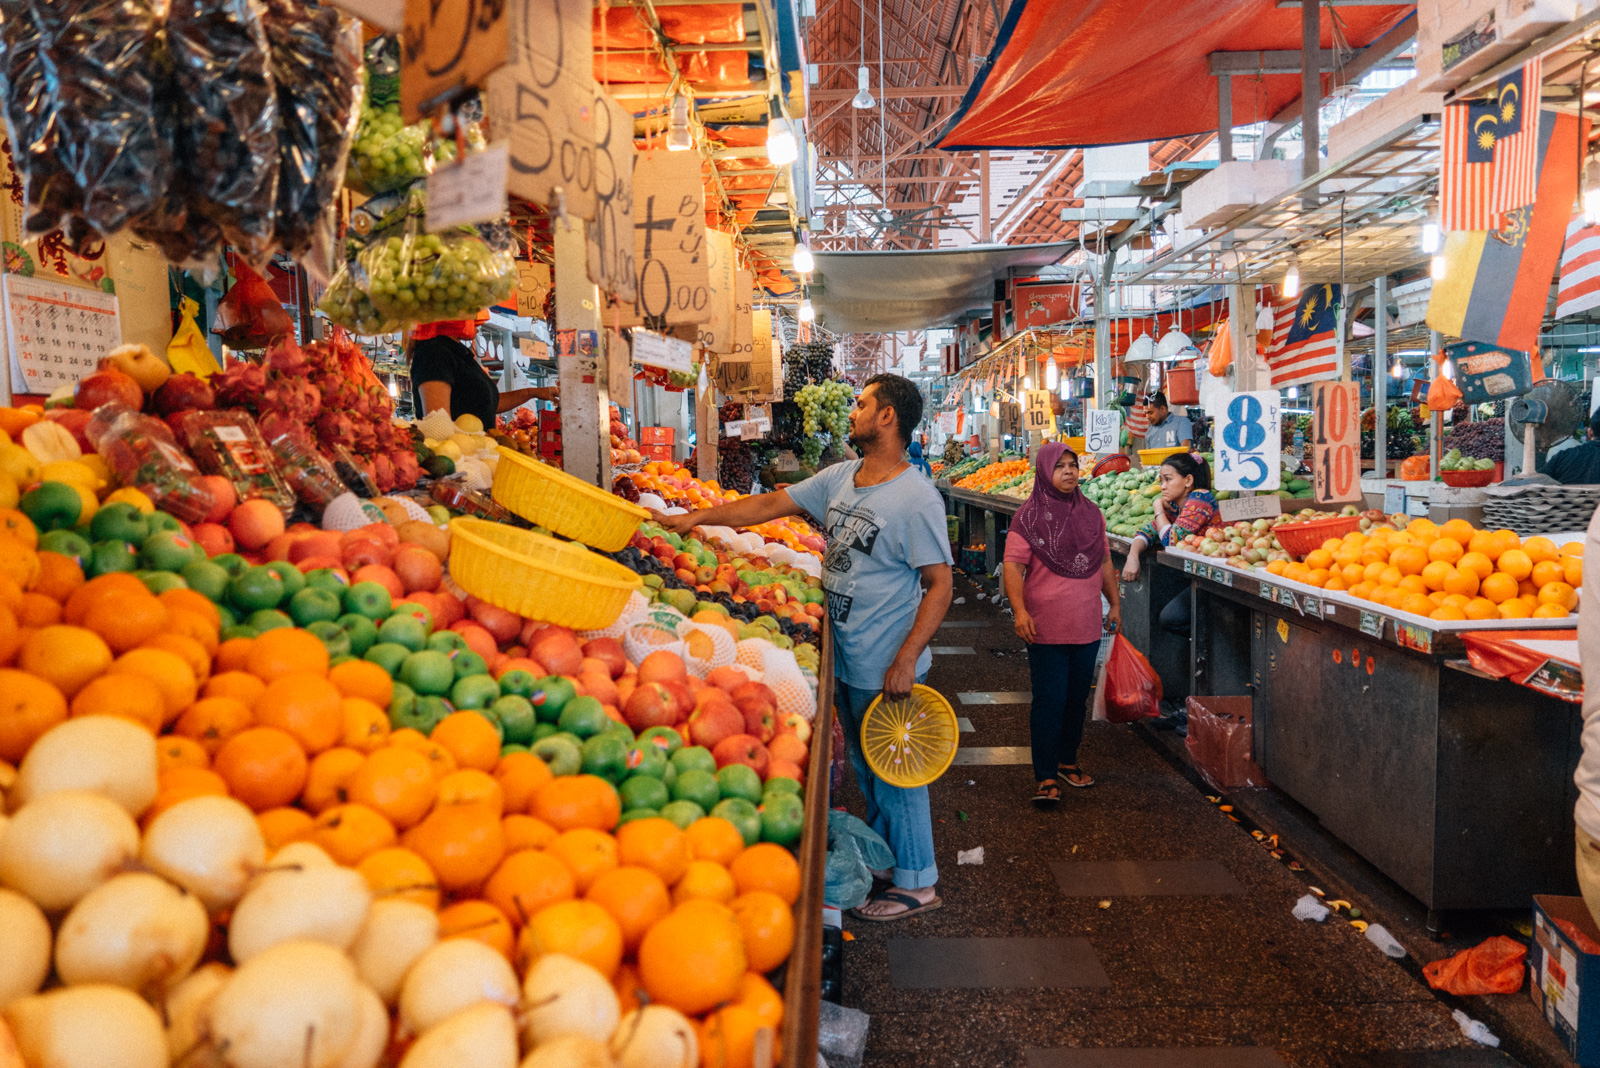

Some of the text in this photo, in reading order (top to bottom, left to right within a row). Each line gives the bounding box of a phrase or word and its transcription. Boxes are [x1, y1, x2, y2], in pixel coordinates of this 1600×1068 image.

[66, 324, 74, 332] 10
[80, 327, 88, 335] 11
[95, 329, 103, 337] 12
[20, 334, 105, 353] 14 15 16 17 18 19
[22, 352, 33, 360] 21
[54, 356, 63, 364] 23
[69, 357, 79, 365] 24
[83, 359, 93, 367] 25
[26, 369, 37, 377] 28
[43, 370, 53, 378] 29
[1029, 393, 1044, 409] 14
[1222, 394, 1266, 452] 8
[1315, 385, 1349, 445] 10
[1165, 430, 1175, 443] N
[1238, 452, 1269, 489] 5
[1322, 444, 1354, 502] 10
[1225, 498, 1264, 509] APPLES
